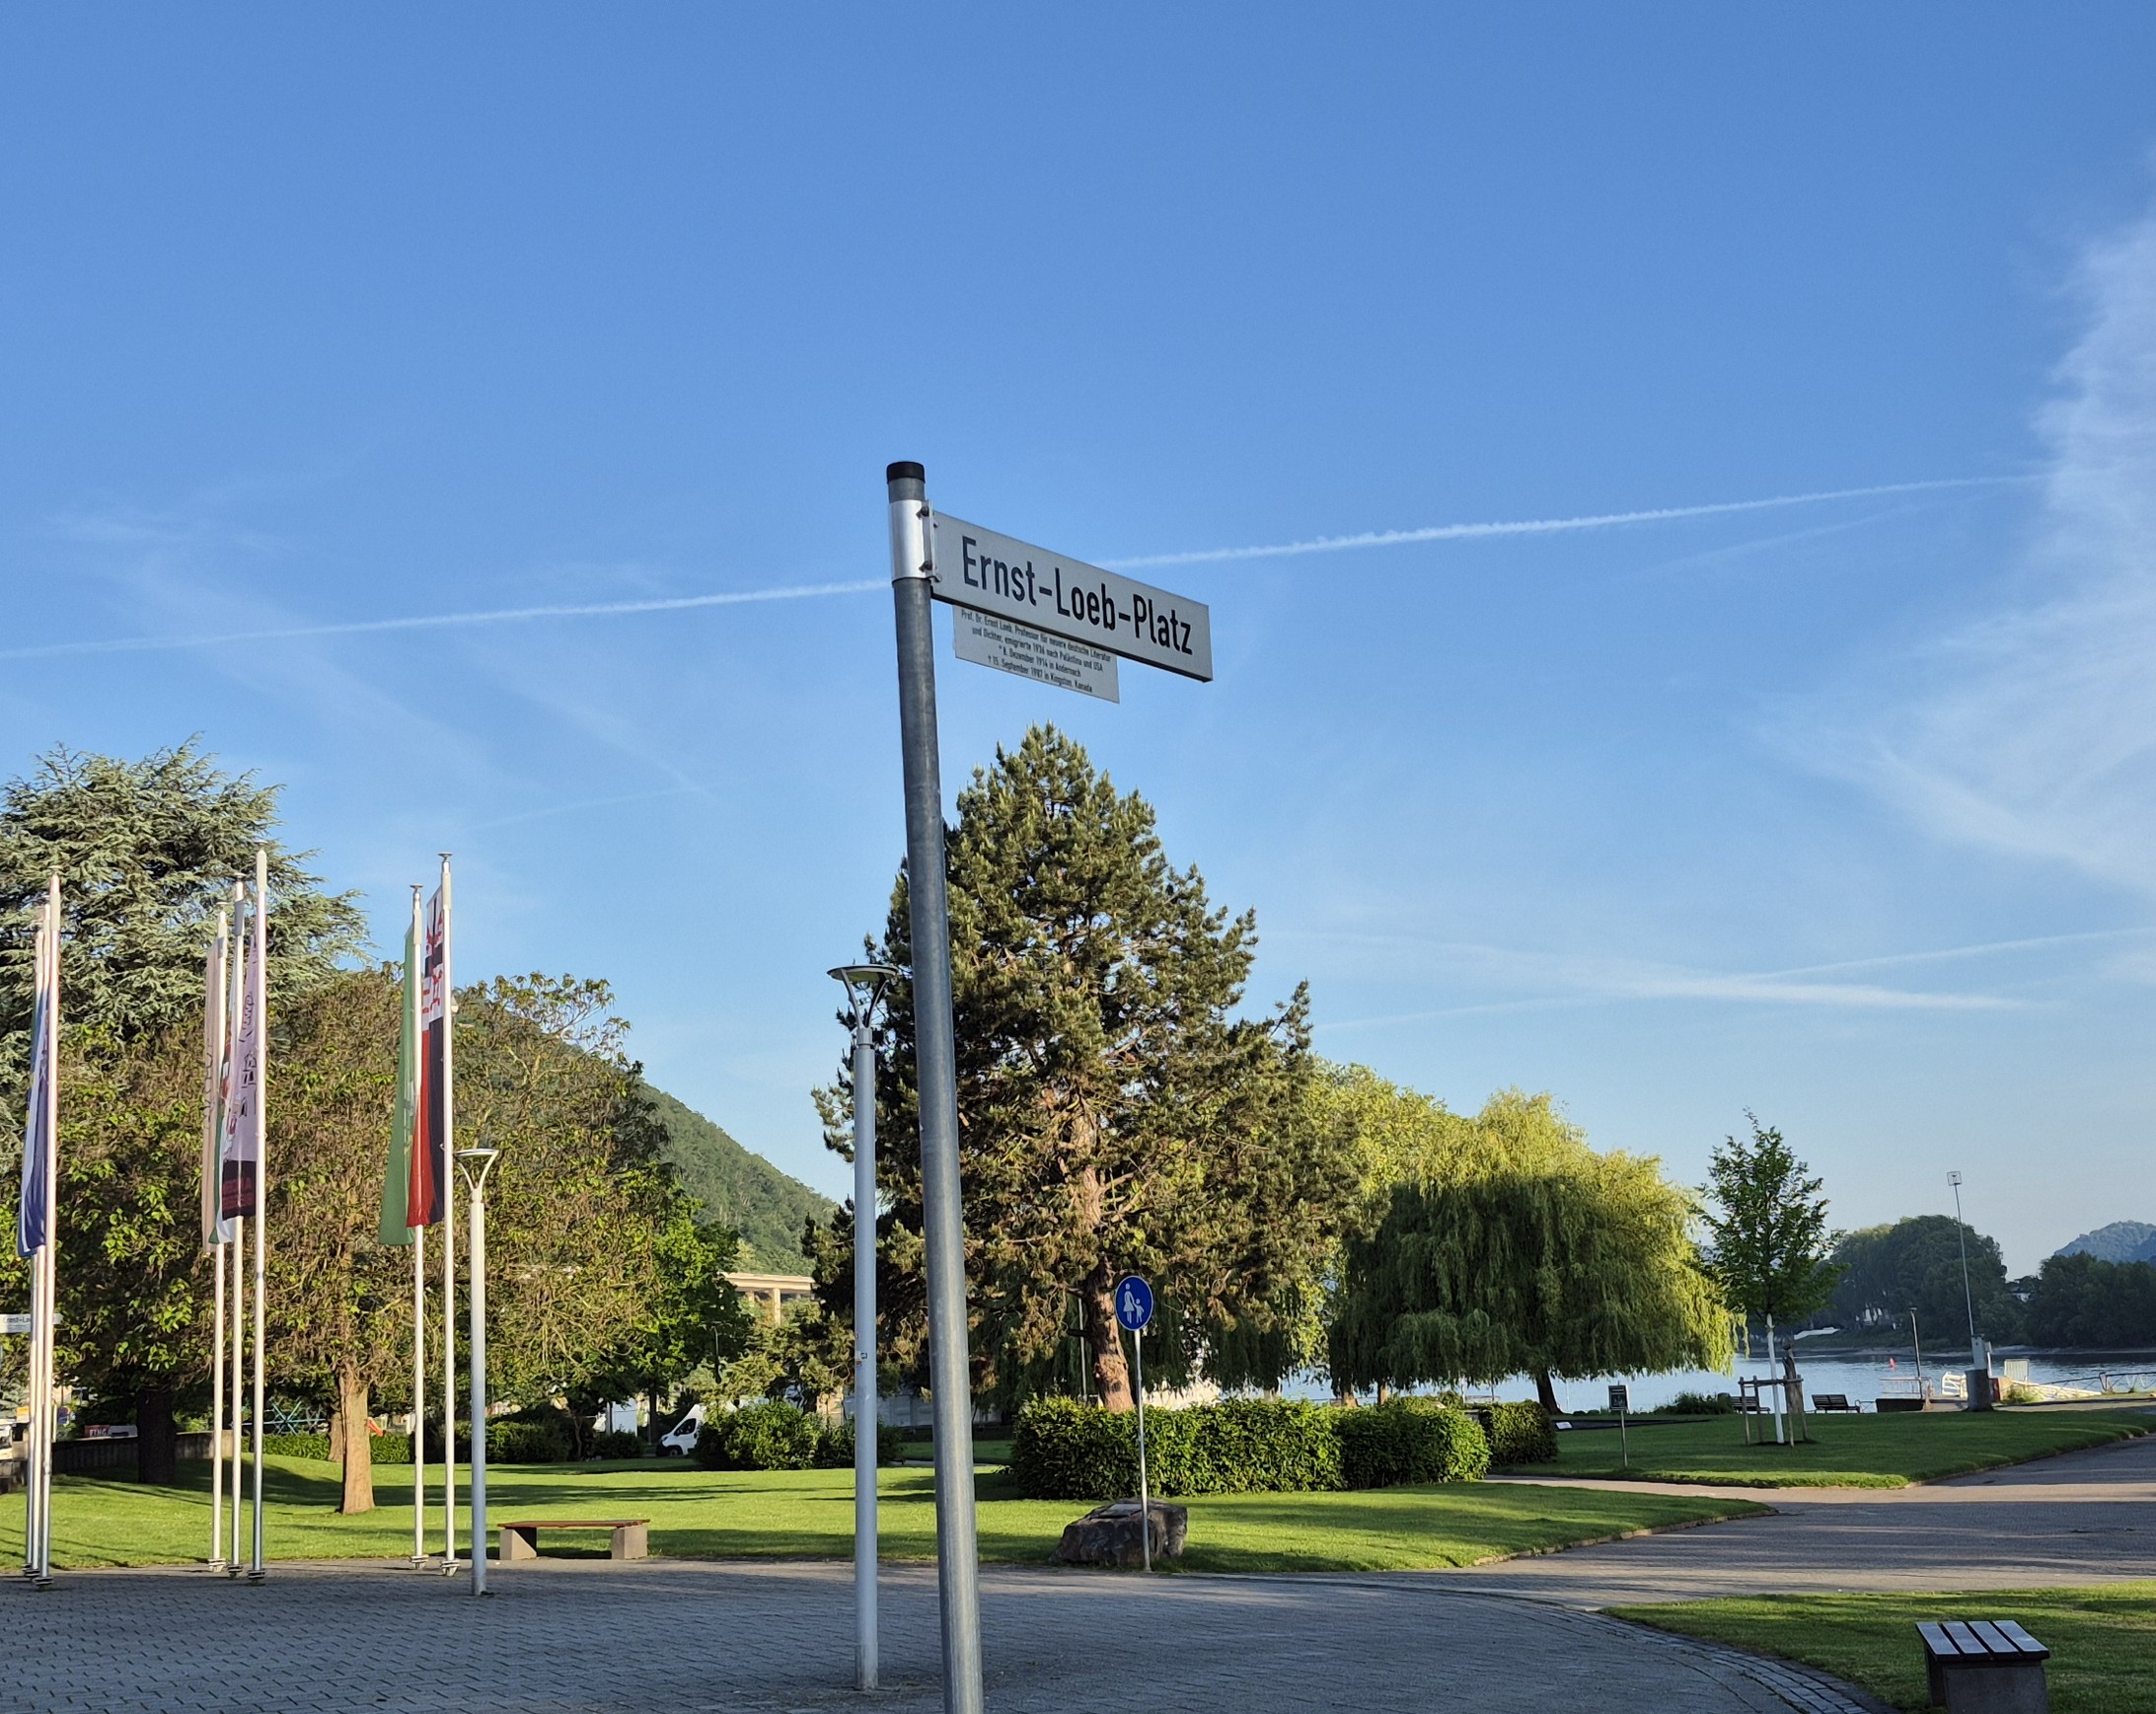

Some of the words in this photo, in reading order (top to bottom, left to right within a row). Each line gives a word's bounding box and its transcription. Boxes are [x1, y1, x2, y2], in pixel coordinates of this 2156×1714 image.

[962, 536, 1193, 655] Ernst-Loeb-Platz
[961, 609, 974, 622] Prof.
[984, 616, 999, 629] Ernst
[1015, 625, 1039, 640] Professor
[1068, 641, 1089, 656] deutsche
[1090, 647, 1111, 662] Literatur
[972, 627, 982, 636] und
[1004, 636, 1031, 651] emigrierte
[1046, 649, 1058, 659] nach
[1083, 660, 1092, 670] und
[1093, 661, 1103, 672] USA
[1002, 657, 1029, 674] September
[1044, 672, 1050, 681] in
[1009, 648, 1035, 664] Dezember
[1049, 660, 1054, 670] in
[1055, 662, 1081, 678] Andernach
